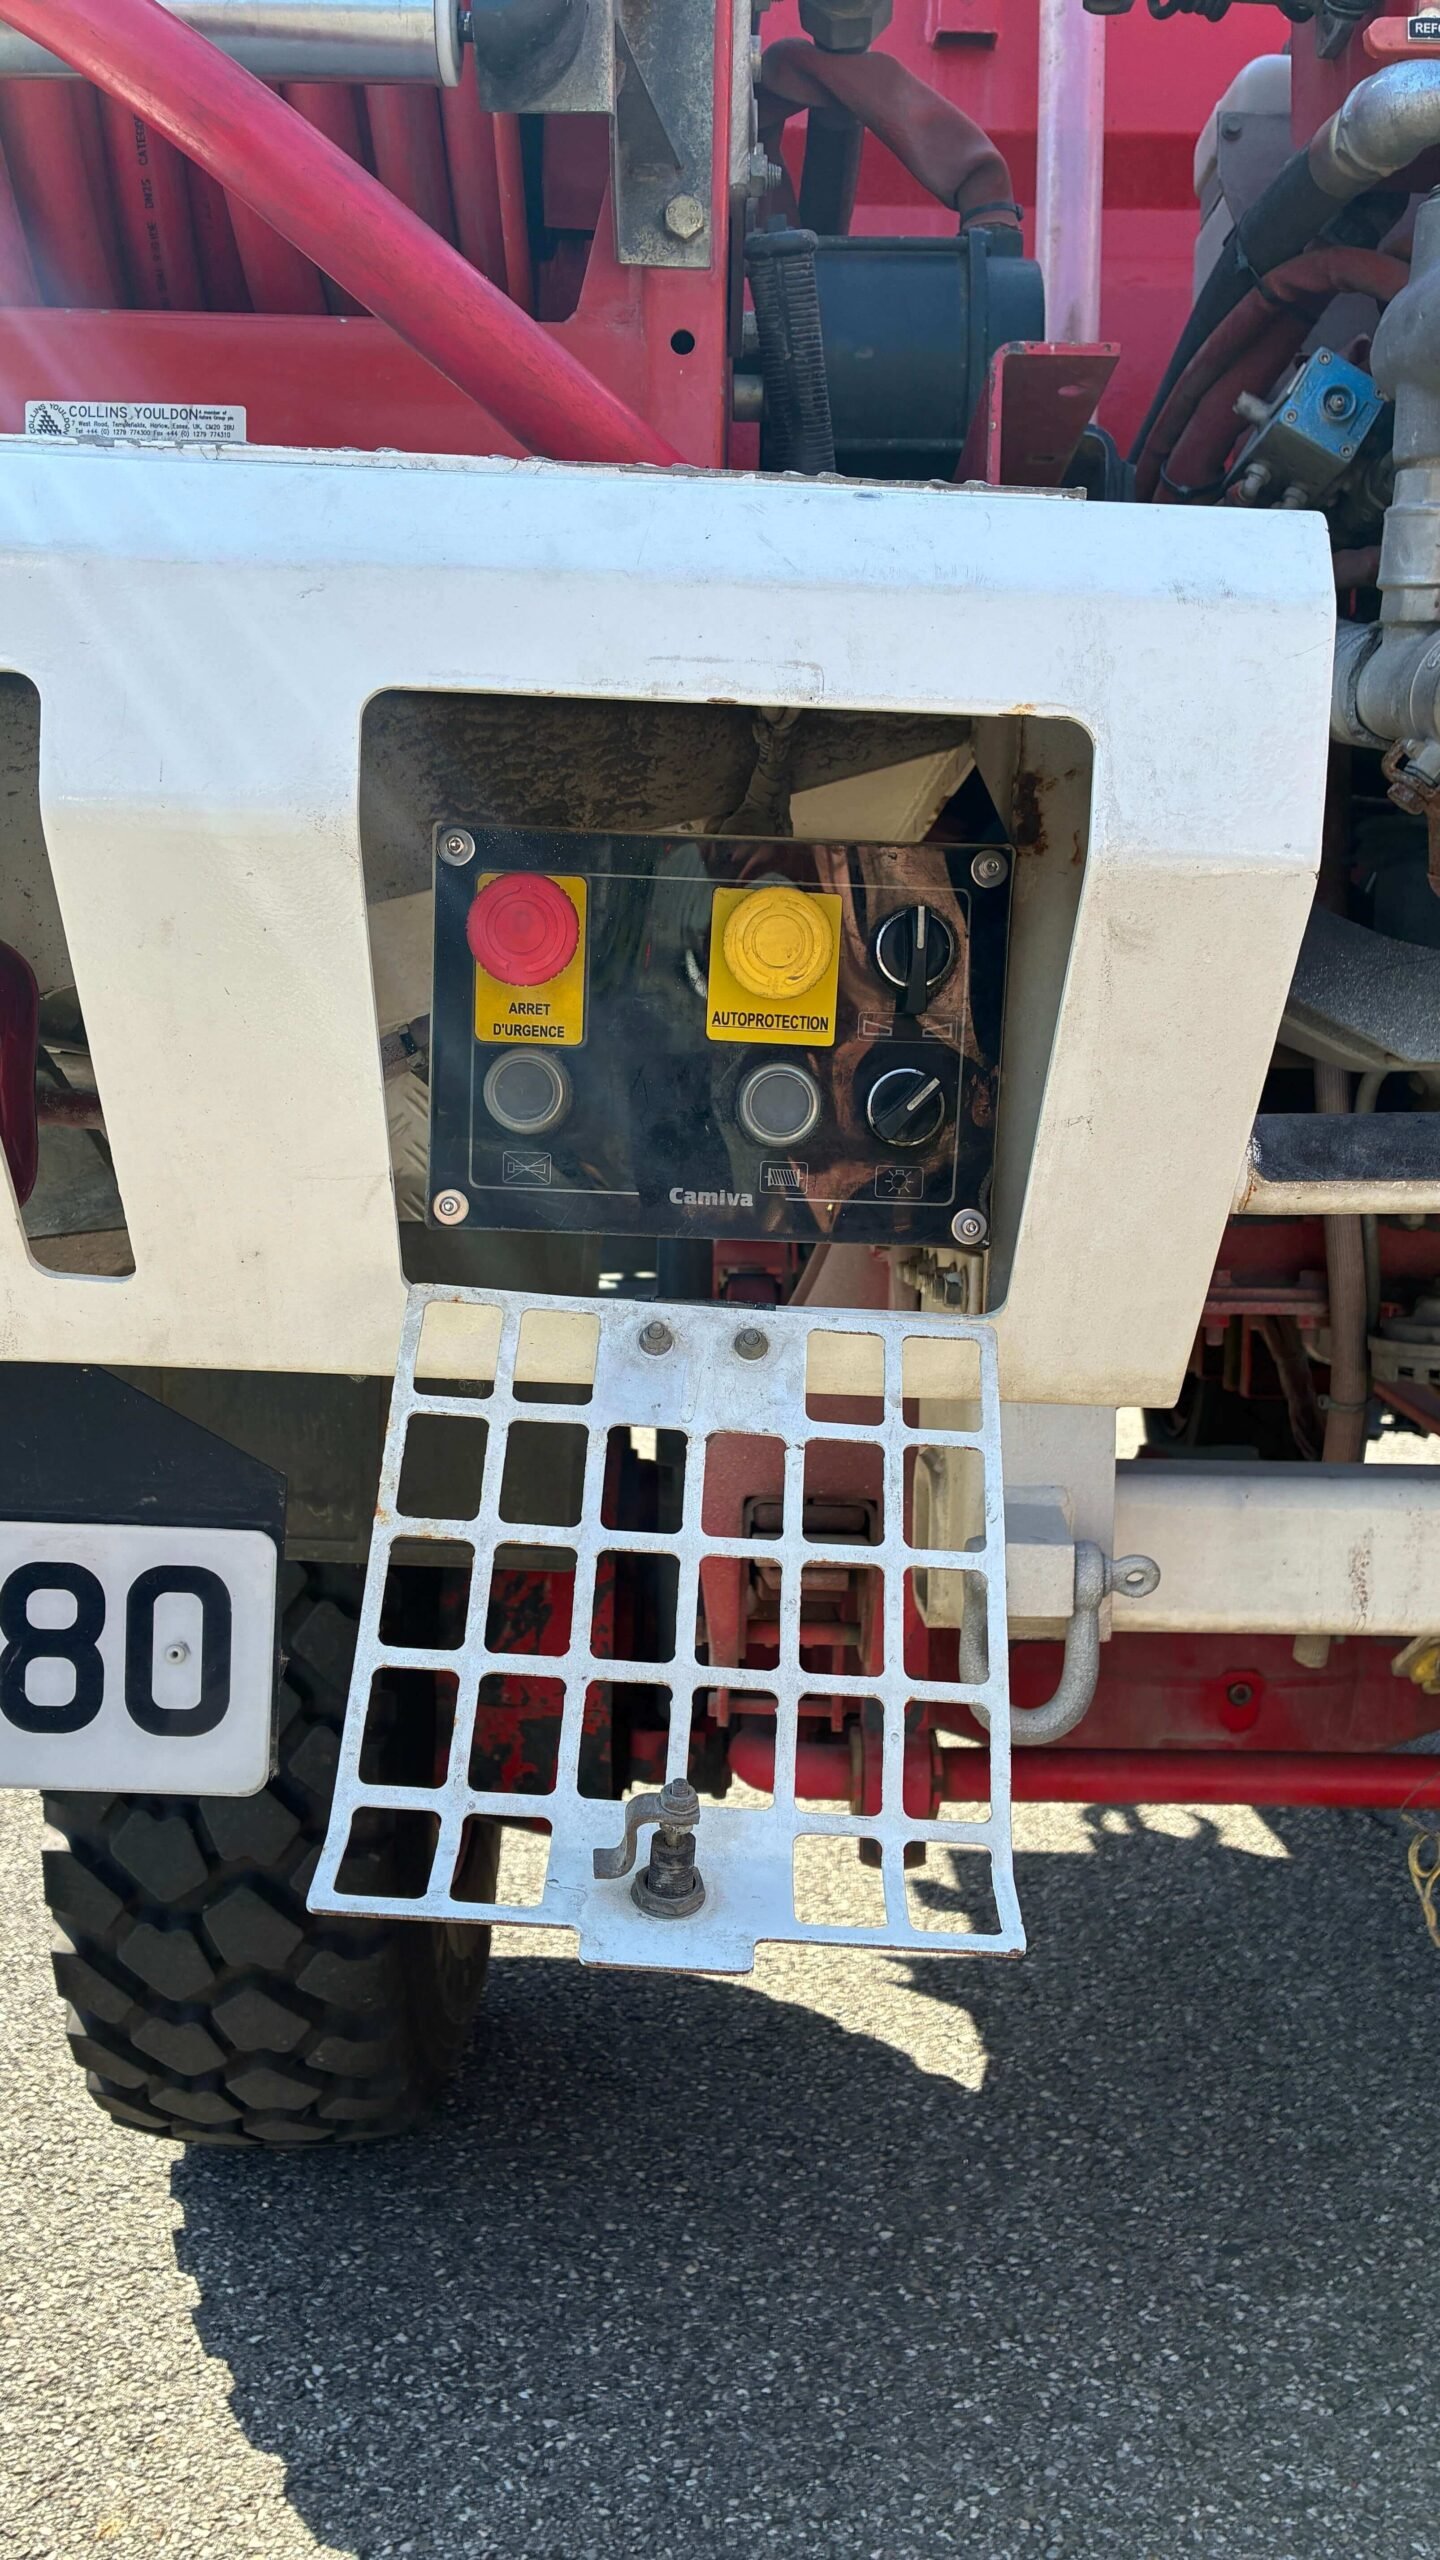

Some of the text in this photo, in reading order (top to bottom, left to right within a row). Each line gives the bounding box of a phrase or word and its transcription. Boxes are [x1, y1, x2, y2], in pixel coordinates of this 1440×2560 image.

[1415, 22, 1440, 34] REF
[141, 178, 154, 209] DN25
[28, 403, 46, 434] COLLINS
[68, 405, 198, 420] COLLINS YOULDON
[100, 427, 110, 436] (0)
[180, 430, 190, 438] (0)
[508, 1002, 551, 1016] ARRET
[711, 1011, 829, 1031] AUTOPROTECTION
[493, 1023, 565, 1038] D'URGENCE
[669, 1187, 754, 1207] Camiva
[0, 1561, 232, 1738] 80
